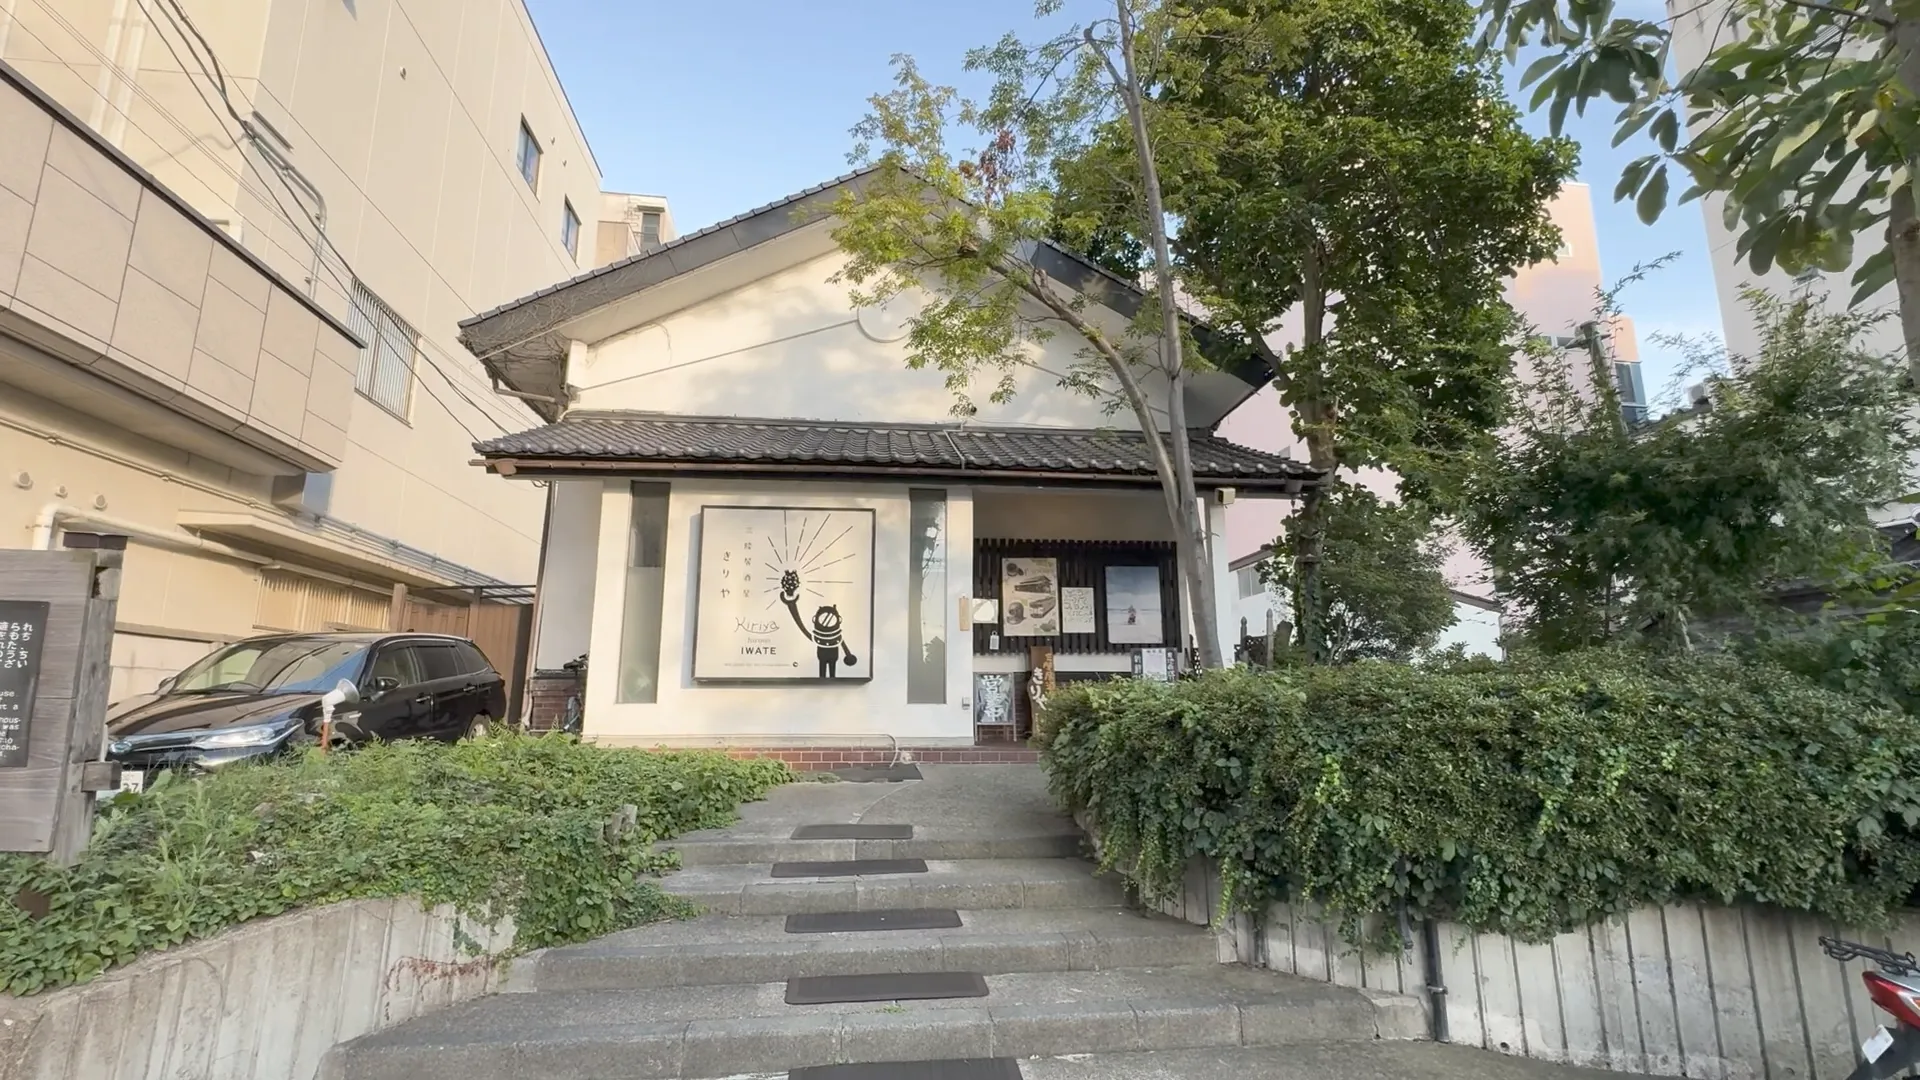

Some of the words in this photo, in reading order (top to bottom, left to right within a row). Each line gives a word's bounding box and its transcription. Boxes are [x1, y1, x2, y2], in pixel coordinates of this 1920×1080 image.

[734, 616, 780, 634] Kiriya
[740, 646, 777, 655] IWATE
[980, 674, 1004, 722] 営業中
